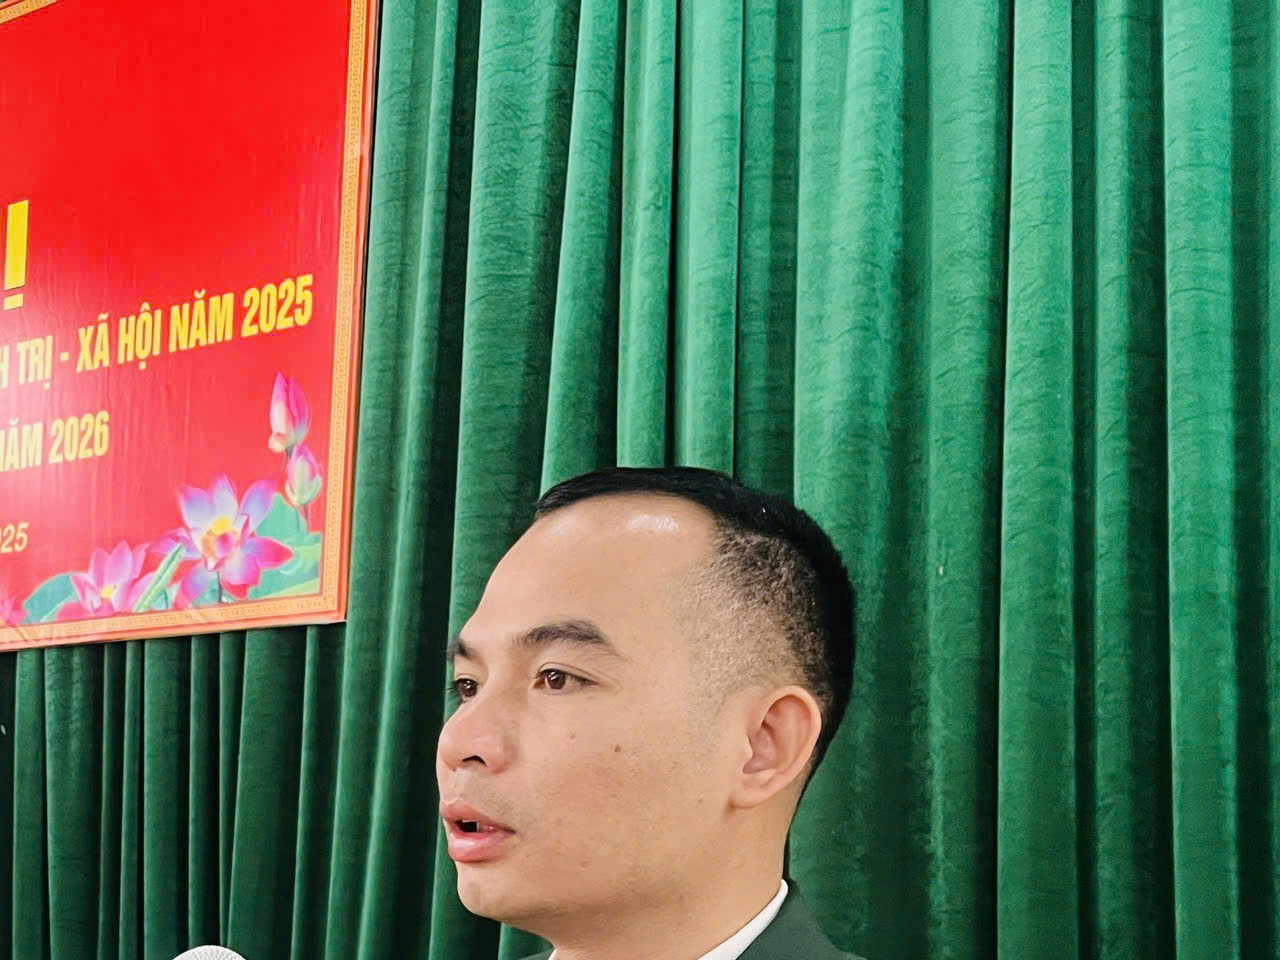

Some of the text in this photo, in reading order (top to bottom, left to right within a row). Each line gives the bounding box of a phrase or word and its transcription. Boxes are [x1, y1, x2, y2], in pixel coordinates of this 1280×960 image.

[17, 335, 53, 390] TRỊ
[76, 312, 110, 373] XÃ
[118, 301, 162, 370] HỘI
[169, 289, 235, 353] NĂM
[241, 274, 313, 337] 2025
[48, 410, 110, 465] 2026
